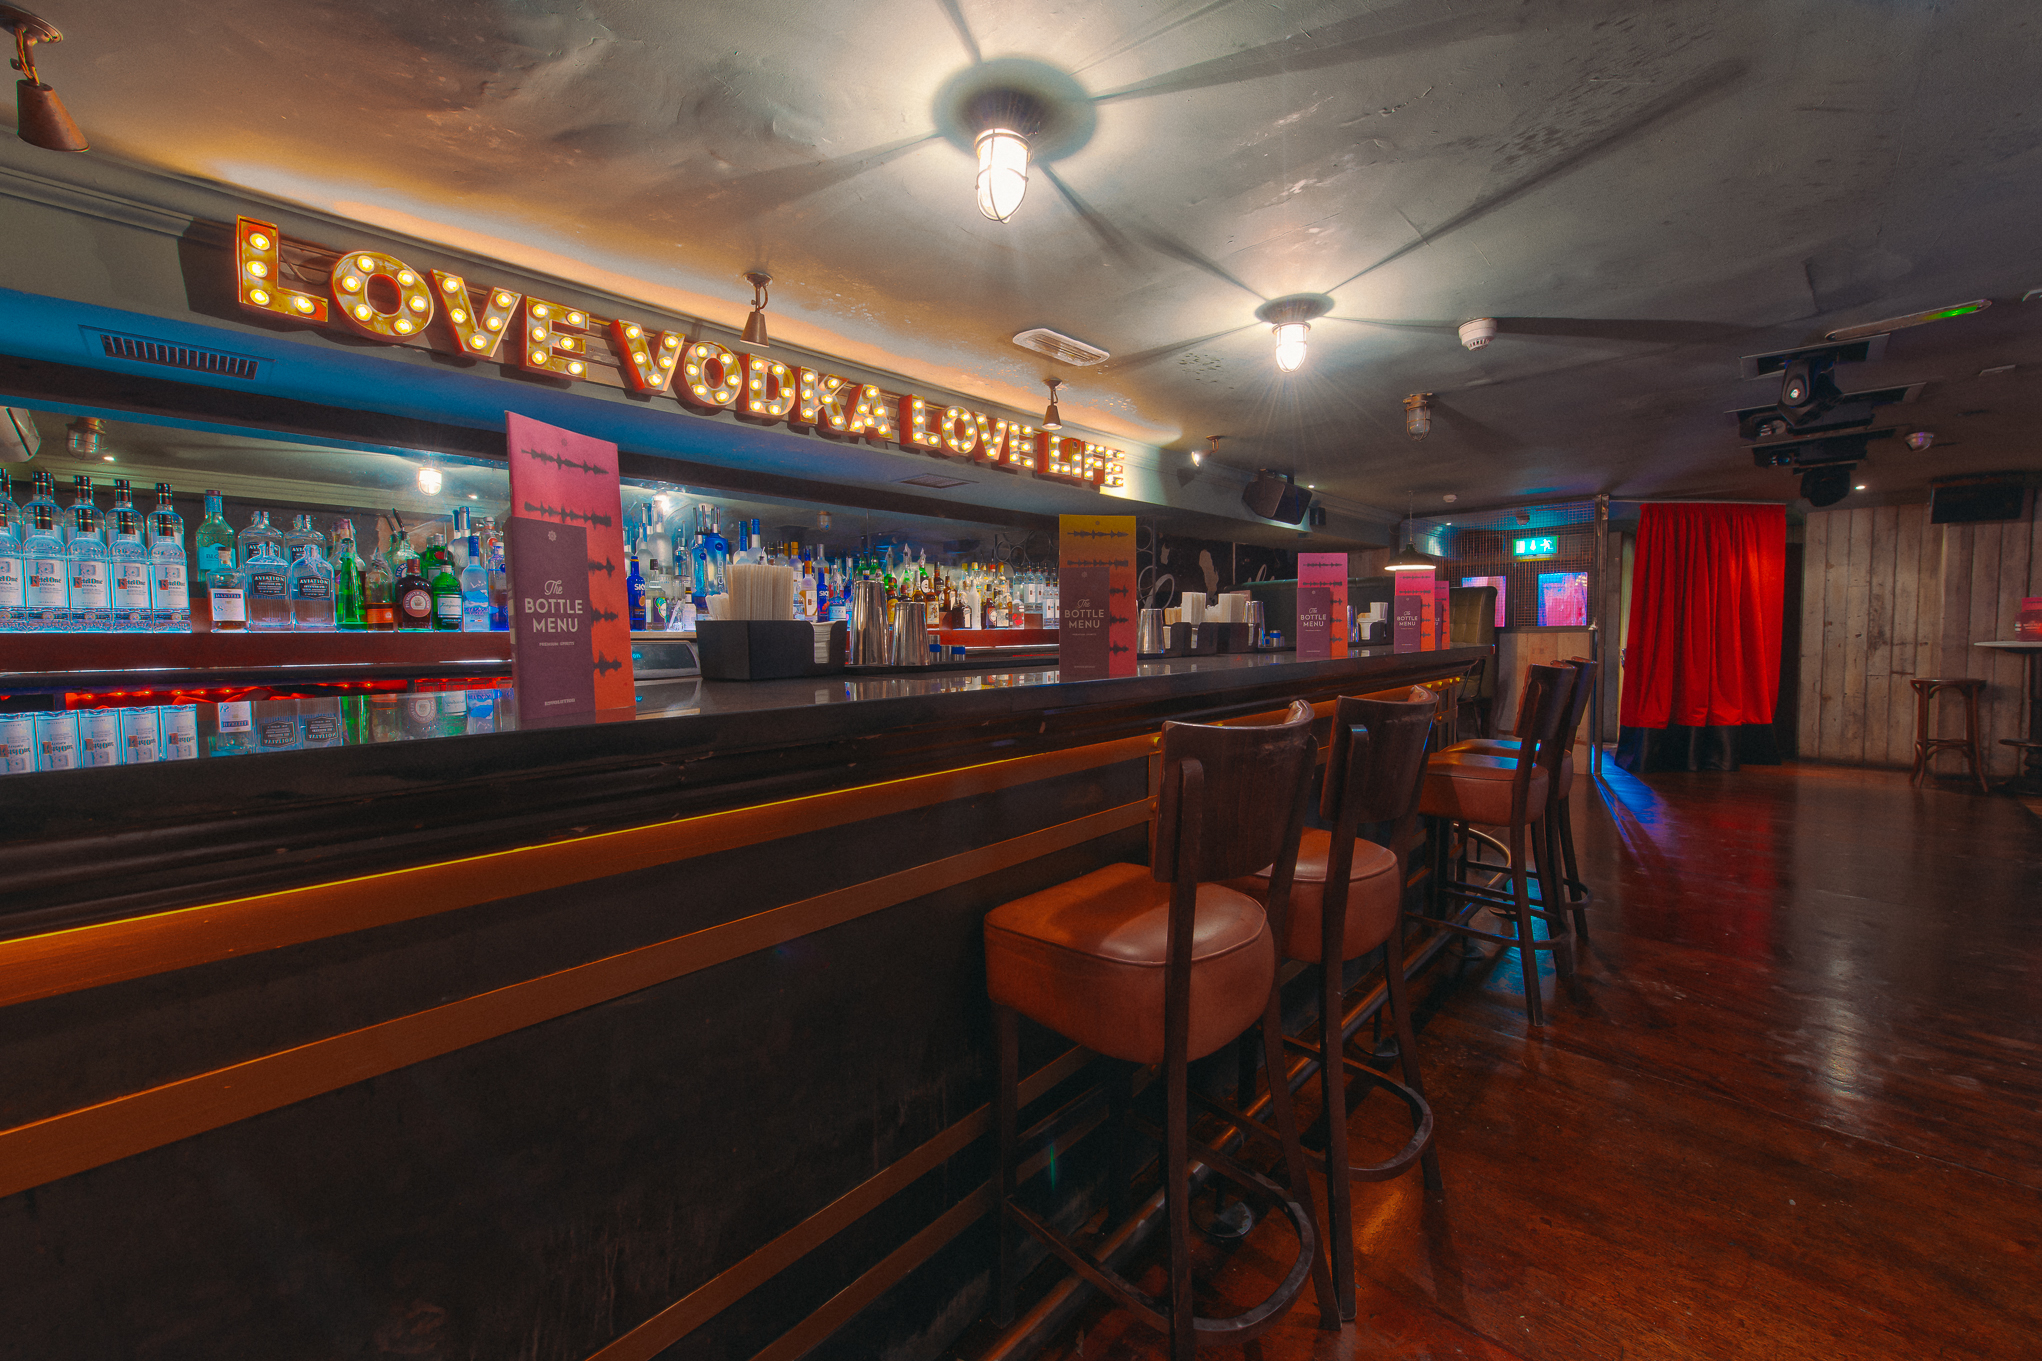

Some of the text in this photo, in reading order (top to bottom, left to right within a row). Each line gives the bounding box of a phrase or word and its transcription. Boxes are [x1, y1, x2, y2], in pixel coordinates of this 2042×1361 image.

[236, 214, 1125, 487] LOVE VODKA LOVE LIFE
[544, 580, 563, 595] The
[524, 598, 583, 613] BOTTLE
[1077, 599, 1090, 608] The
[1064, 609, 1104, 618] BOTTLE
[533, 617, 578, 632] MENU
[1069, 620, 1100, 628] MENU
